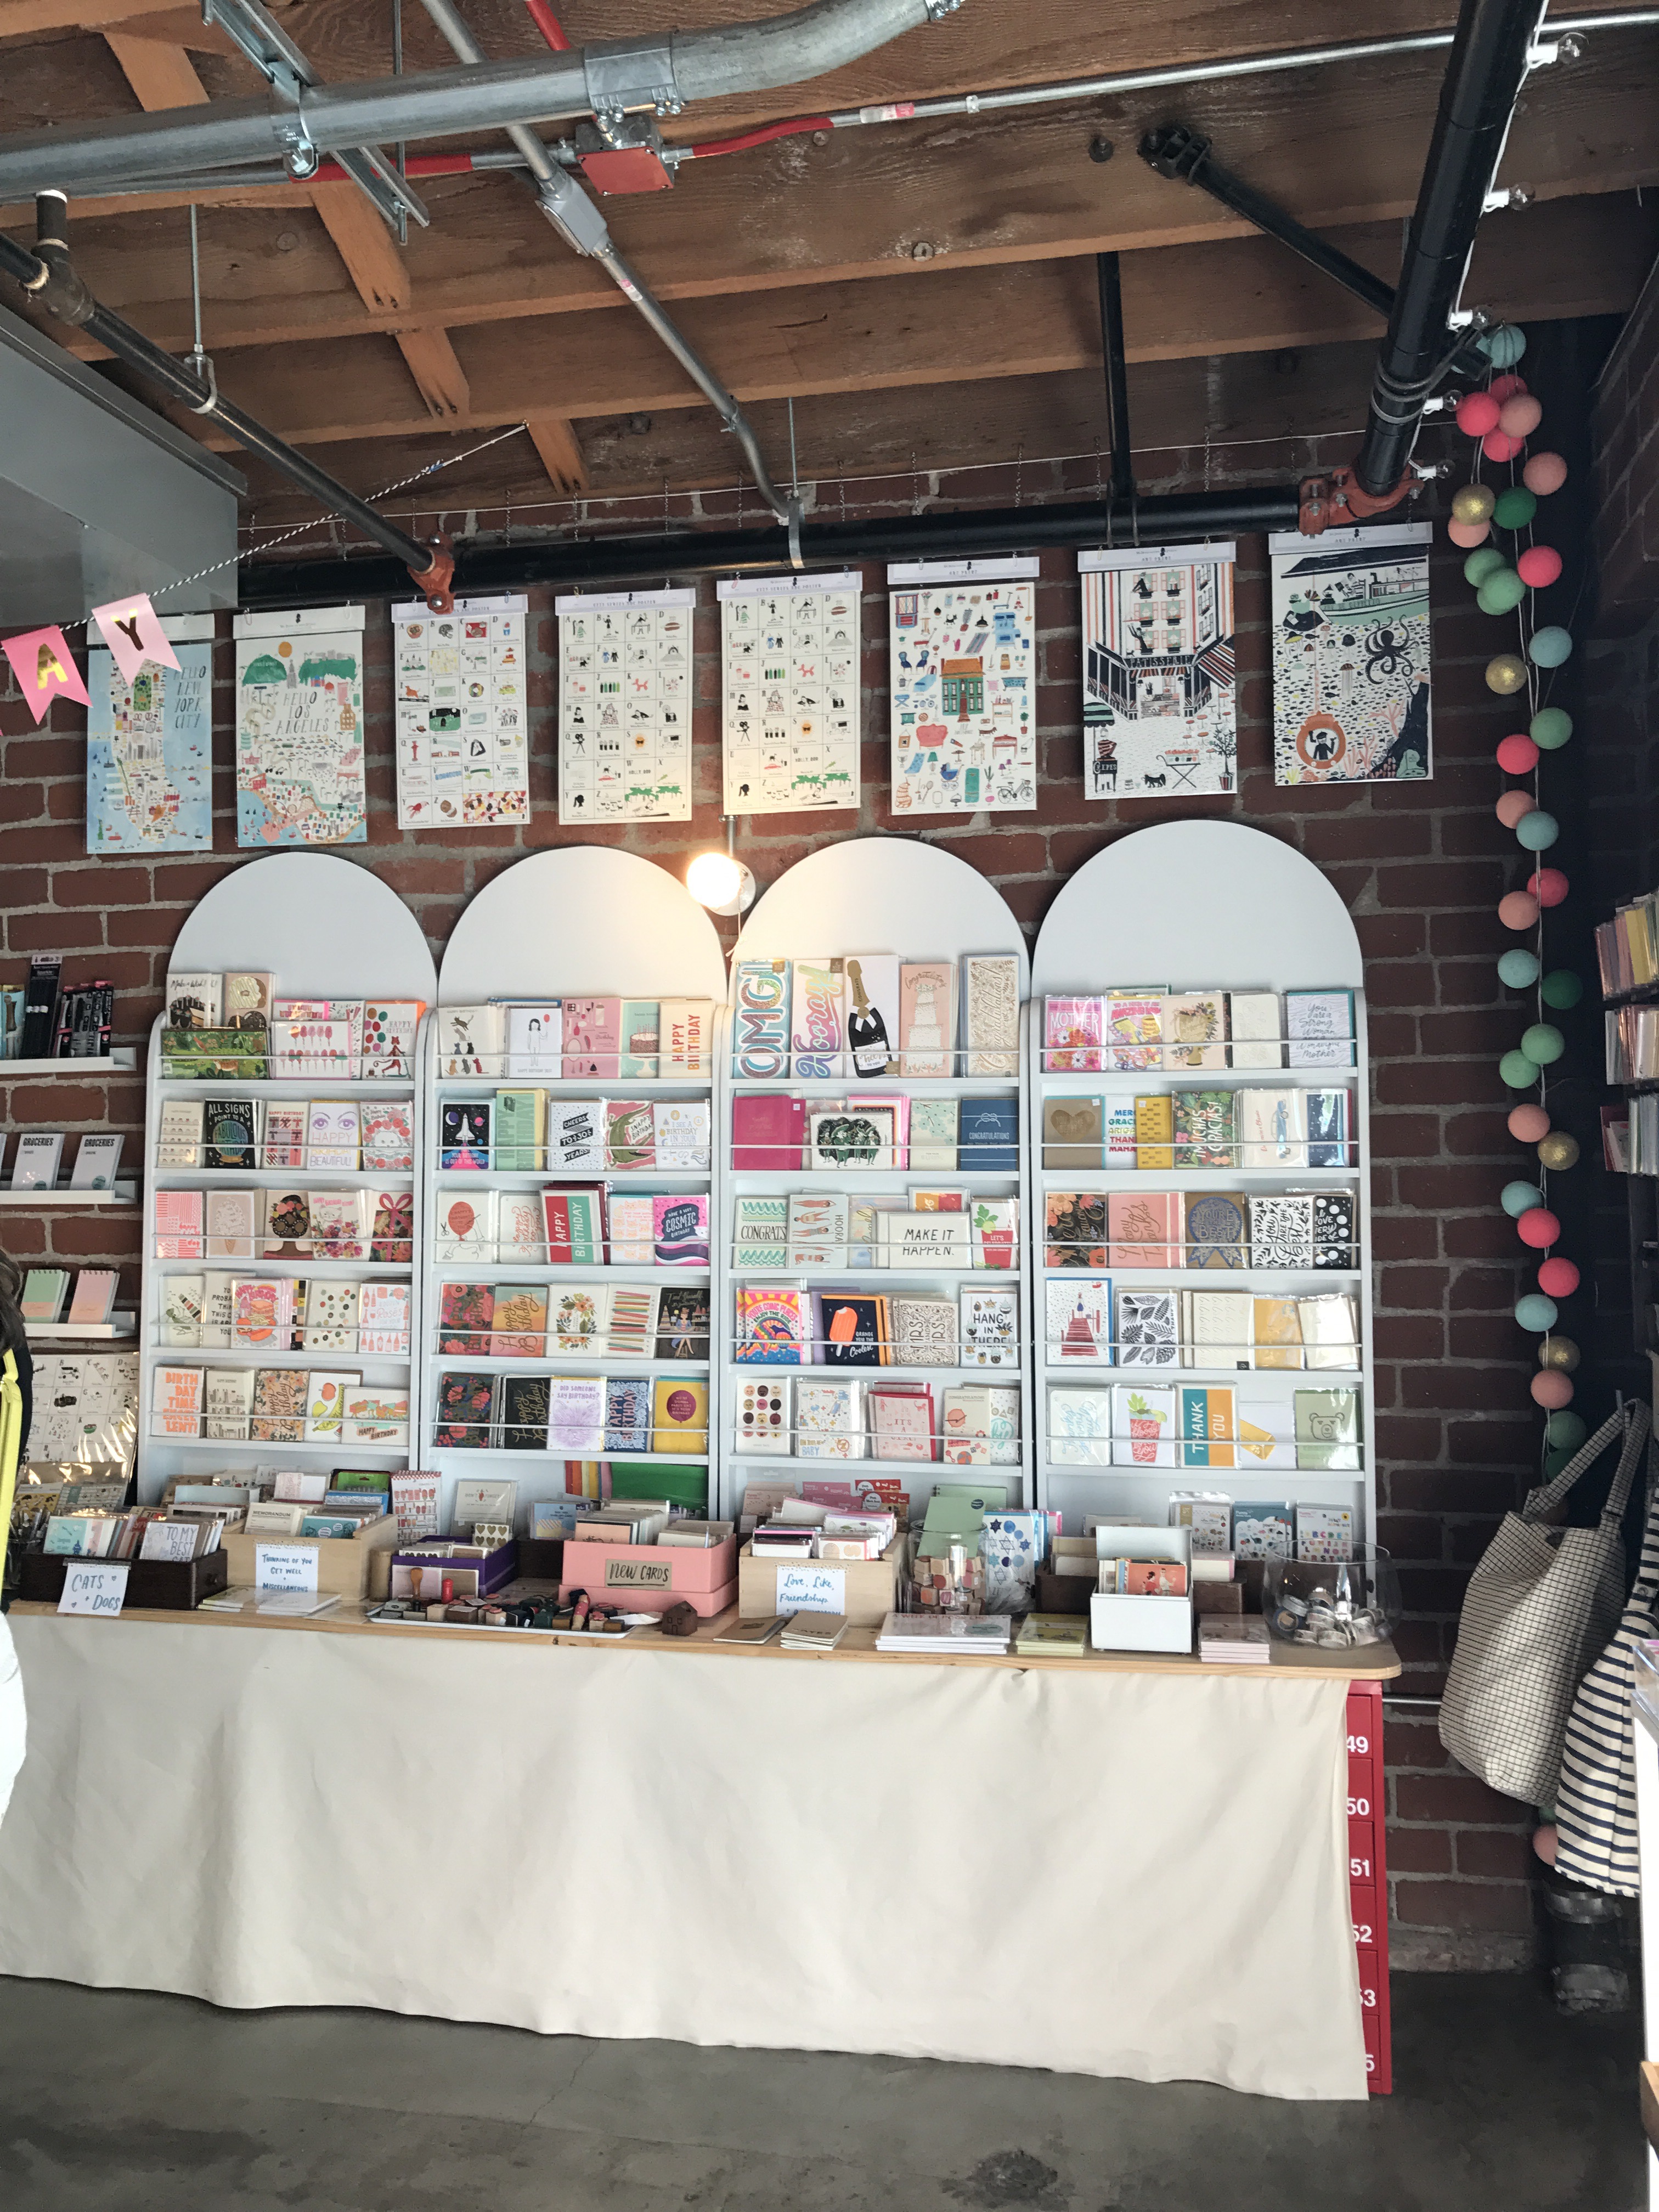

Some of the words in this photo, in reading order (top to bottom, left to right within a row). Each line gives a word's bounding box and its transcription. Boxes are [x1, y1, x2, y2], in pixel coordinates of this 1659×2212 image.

[110, 608, 144, 651] Y
[37, 644, 68, 689] A
[1131, 656, 1190, 668] PATISSERIE
[284, 692, 317, 706] HELLO
[289, 705, 310, 719] LOS
[175, 713, 200, 728] CITY
[276, 718, 329, 734] ANGELES
[1049, 1012, 1100, 1036] MOTHER
[1299, 1018, 1334, 1028] Strong
[1302, 1028, 1335, 1036] Woman
[672, 1024, 685, 1062] HAPPY
[687, 1014, 701, 1070] BITHDAY
[1302, 1049, 1335, 1058] Mother
[208, 1104, 223, 1118] ALL
[225, 1103, 250, 1118] SIGNS
[215, 1115, 230, 1123] POINT
[564, 1116, 587, 1128] CHEERS
[631, 1115, 651, 1131] SNAPPY
[1208, 1101, 1223, 1152] GRACIAS!
[23, 1138, 54, 1146] GROCERIES
[84, 1138, 115, 1147] GROCERIES
[313, 1132, 353, 1144] HAPPY
[562, 1137, 573, 1145] TO
[577, 1131, 588, 1141] 30
[310, 1156, 351, 1166] BEAUTIFUL!
[566, 1149, 588, 1160] YEARS
[665, 1212, 696, 1233] COSMIC
[741, 1226, 787, 1240] CONGRATS
[904, 1229, 939, 1241] MAKE
[942, 1229, 955, 1240] IT
[1198, 1224, 1233, 1238] BEST
[753, 1311, 768, 1323] ENJOY
[973, 1313, 1003, 1324] HANG
[849, 1344, 874, 1358] Coolest
[166, 1372, 198, 1385] BIRTH
[175, 1385, 198, 1397] DAY
[168, 1396, 199, 1410] TIME,
[1192, 1401, 1204, 1454] THANK
[1213, 1414, 1225, 1440] YOU
[371, 1429, 397, 1440] BIRTHDAY
[802, 1446, 819, 1456] BABY
[166, 1526, 179, 1541] TO
[180, 1526, 198, 1540] MY
[170, 1541, 194, 1555] BEST
[262, 1554, 290, 1563] THINKING
[640, 1565, 669, 1583] CARDS
[71, 1573, 105, 1592] CATS
[783, 1573, 809, 1589] Love,
[812, 1576, 834, 1591] Like,
[92, 1594, 121, 1611] DOGS
[779, 1593, 828, 1605] Friendship
[1346, 1736, 1368, 1753] 49
[1347, 1797, 1369, 1815] 50
[1351, 1859, 1370, 1877] 51
[1352, 1925, 1372, 1943] 52
